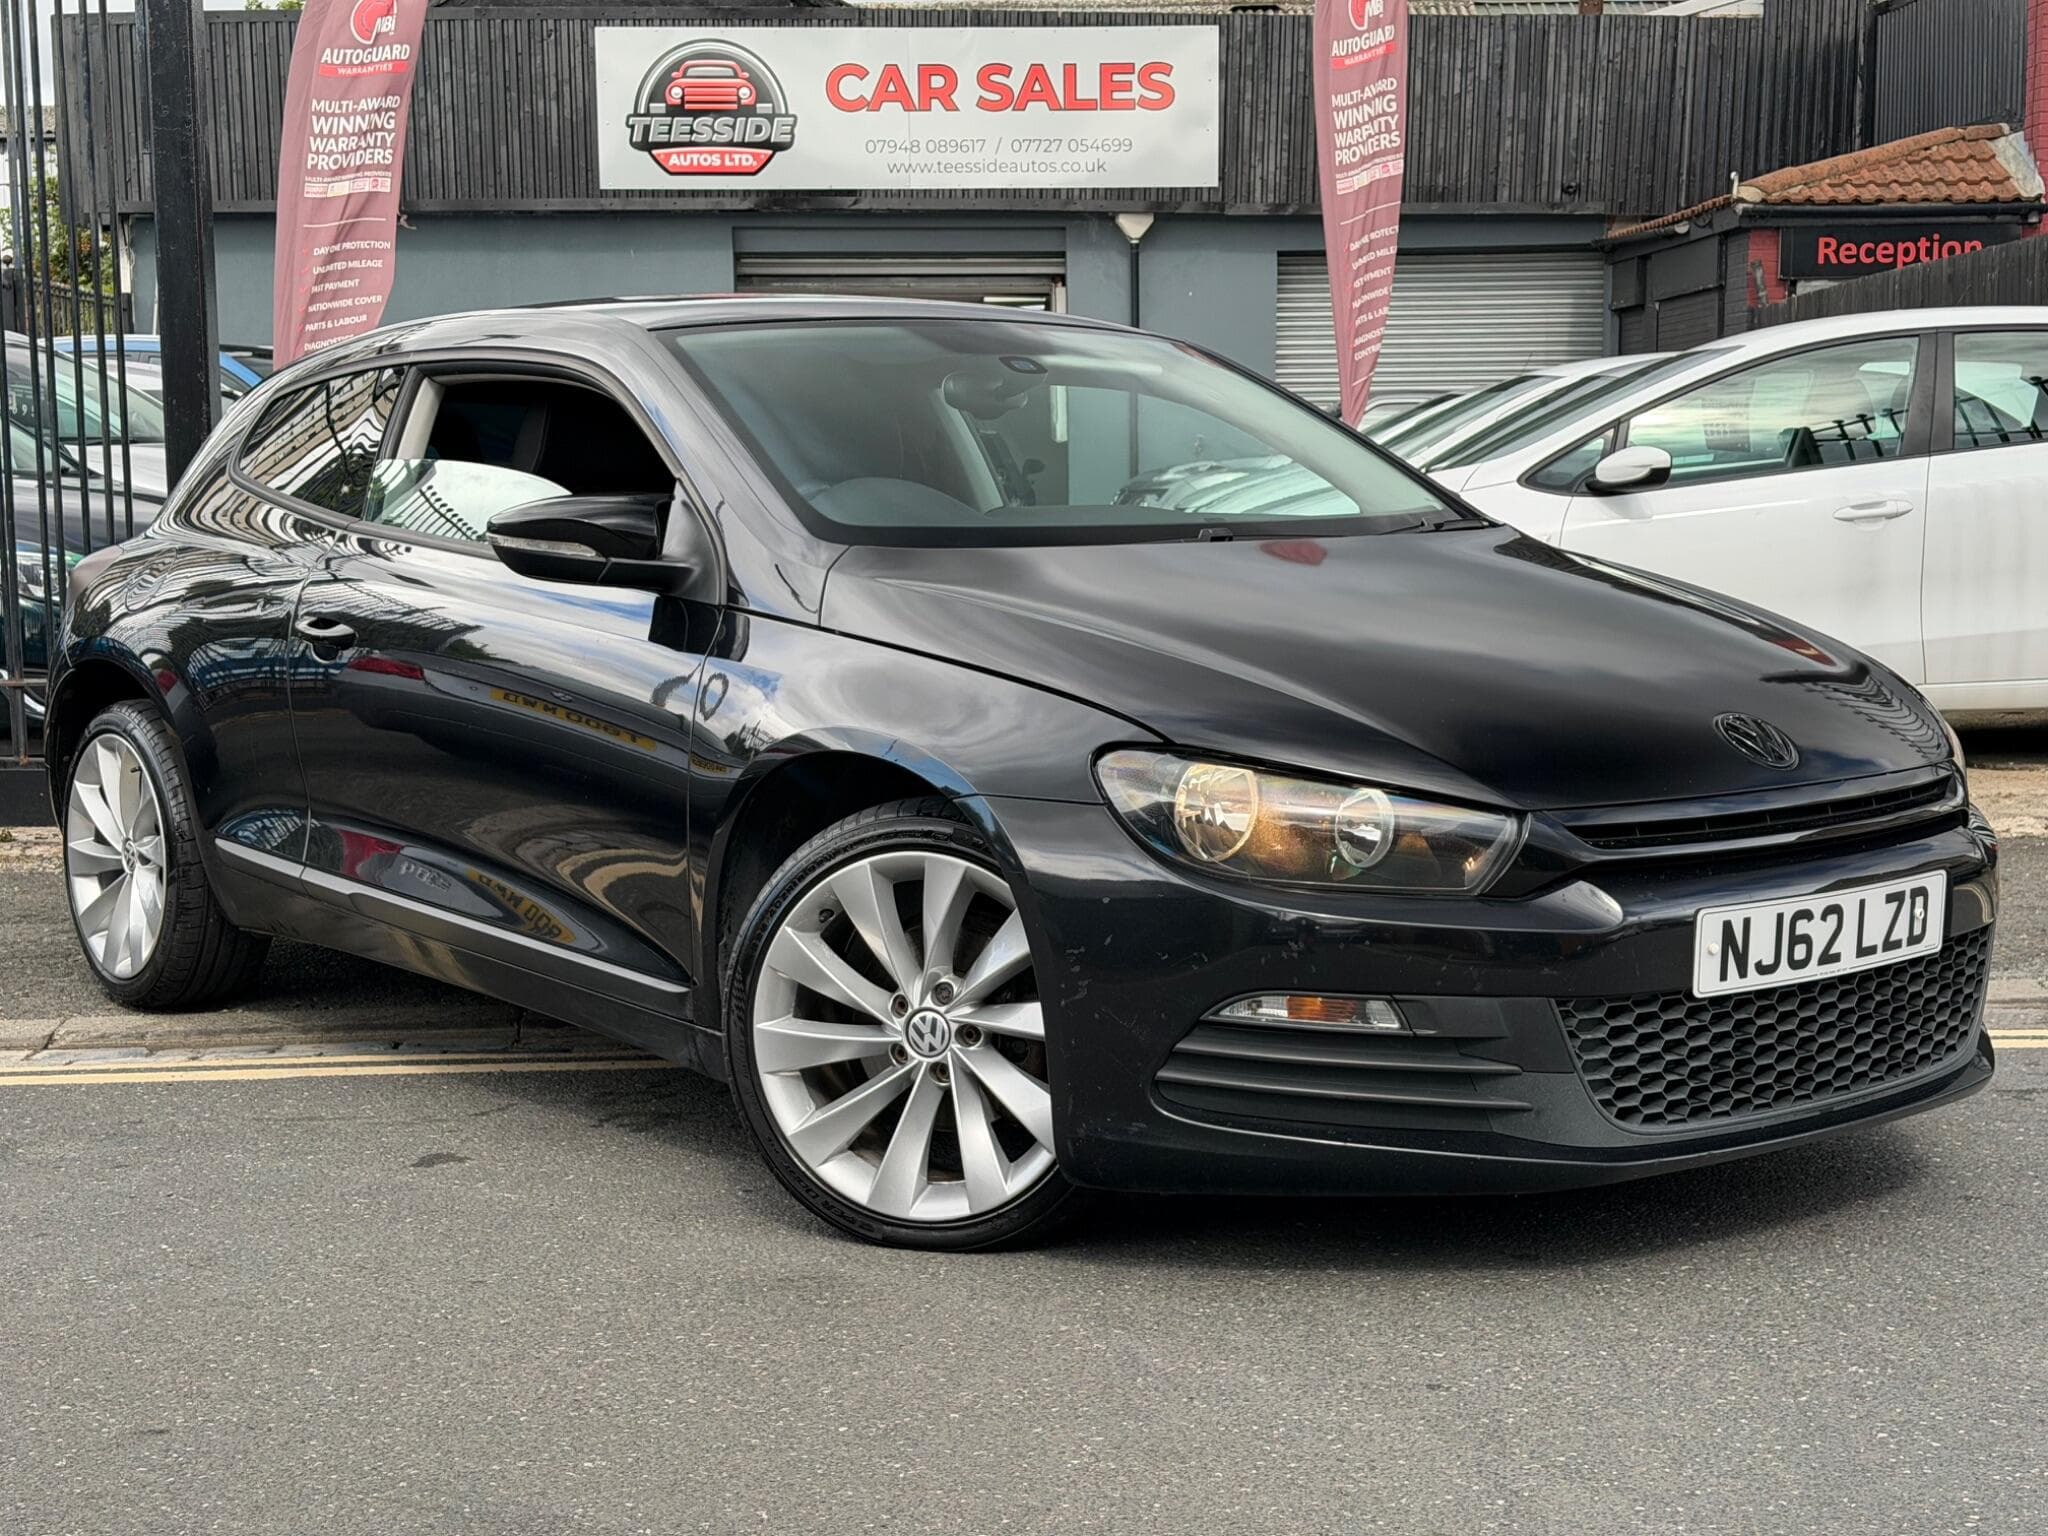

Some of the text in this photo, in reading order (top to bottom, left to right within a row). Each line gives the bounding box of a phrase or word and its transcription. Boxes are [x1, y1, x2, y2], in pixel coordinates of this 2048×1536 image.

[1332, 24, 1395, 57] AUTOGUARD
[320, 44, 410, 65] AUTOGUARD
[336, 63, 393, 75] WARRANTIES
[826, 61, 1176, 112] CAR SALES
[312, 96, 400, 113] MULTI-AWARD
[312, 112, 395, 134] WINNING
[628, 116, 796, 143] TEESSIDE
[310, 132, 395, 153] WARRANTY
[865, 139, 921, 154] 07948
[925, 139, 986, 154] 089617
[1011, 138, 1062, 153] 07727
[1067, 138, 1133, 153] 054699
[307, 150, 393, 170] PROVIDERS
[669, 153, 757, 167] AUTOS LTD.
[887, 158, 1107, 175] www.teessideautos.co.uk
[1817, 234, 1983, 270] Reception
[348, 259, 383, 269] MILEAGE
[324, 279, 360, 291] PAYMENT
[354, 295, 382, 305] COVER
[334, 314, 367, 327] LABOUR
[1719, 886, 1929, 982] NJ62 LZD
